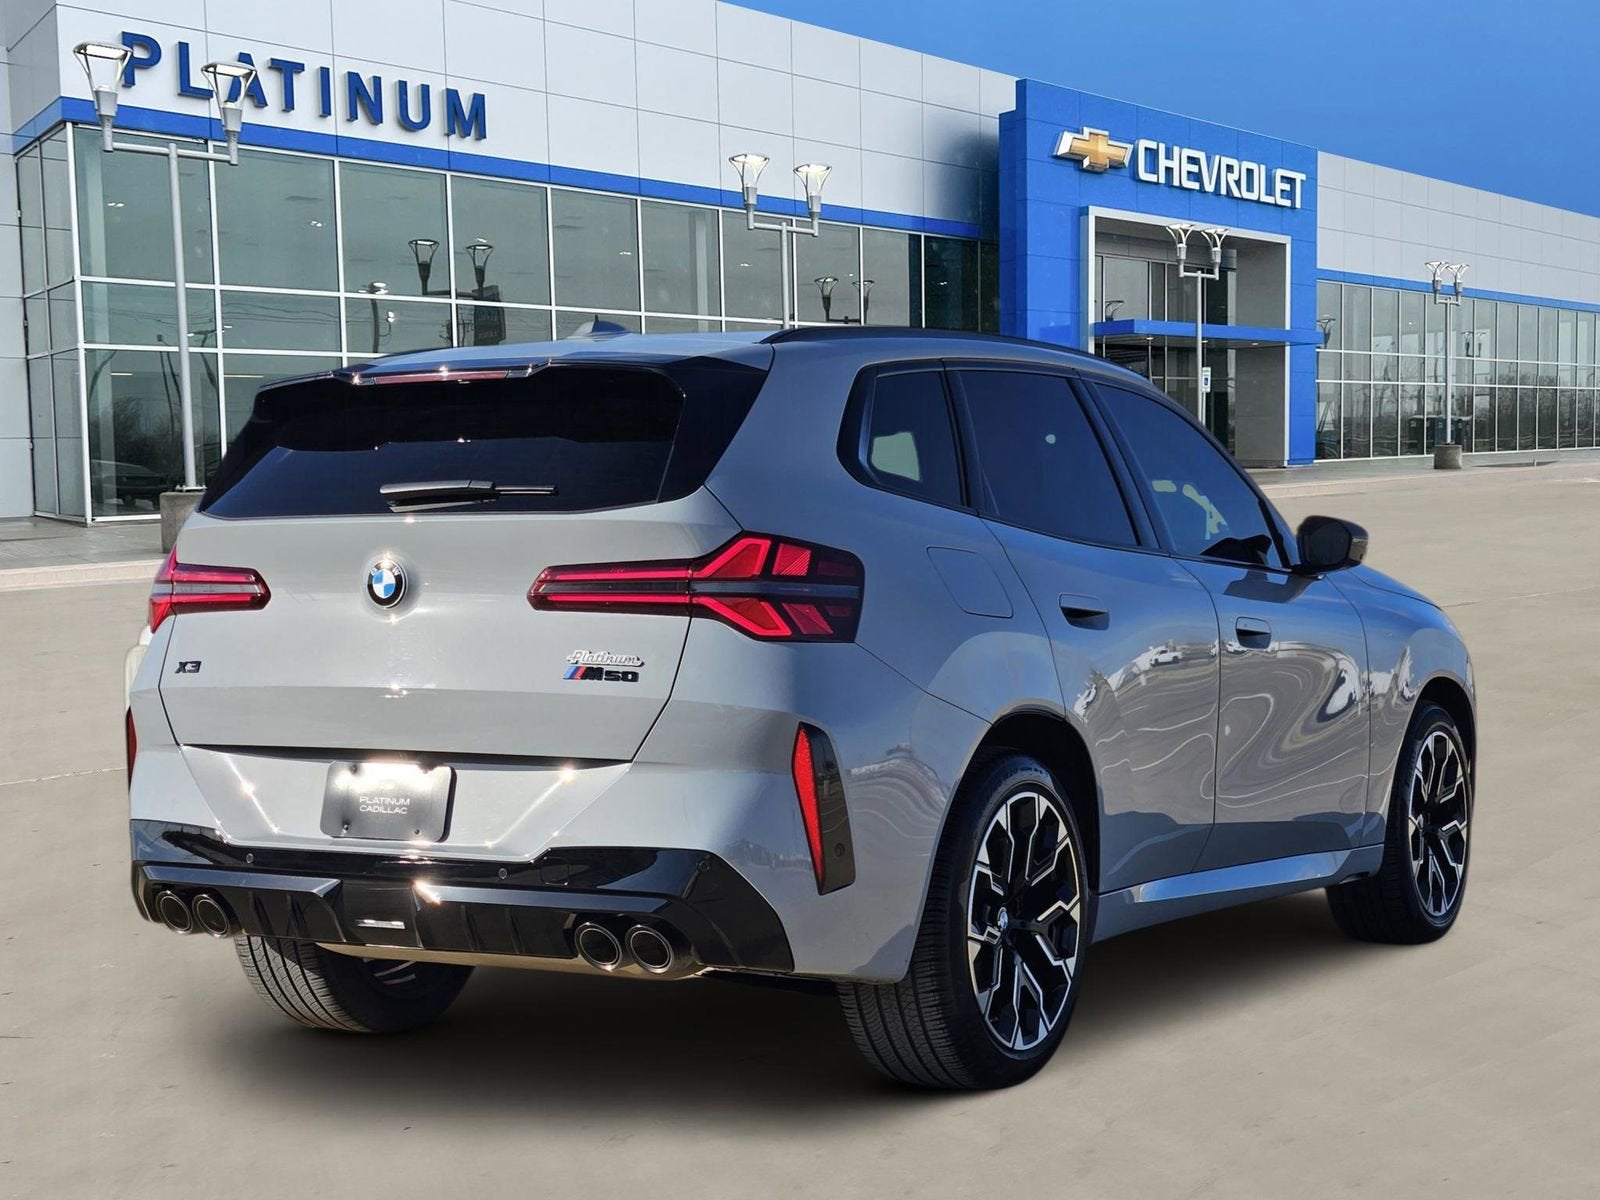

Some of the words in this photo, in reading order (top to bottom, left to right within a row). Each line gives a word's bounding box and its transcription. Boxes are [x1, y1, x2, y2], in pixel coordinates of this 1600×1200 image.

[121, 31, 487, 141] PLATINUM
[1136, 139, 1306, 209] CHEVROLET
[566, 649, 644, 667] Platinum
[175, 660, 202, 674] X3
[359, 796, 410, 806] PLATINUM
[359, 805, 408, 814] CADILLAC
